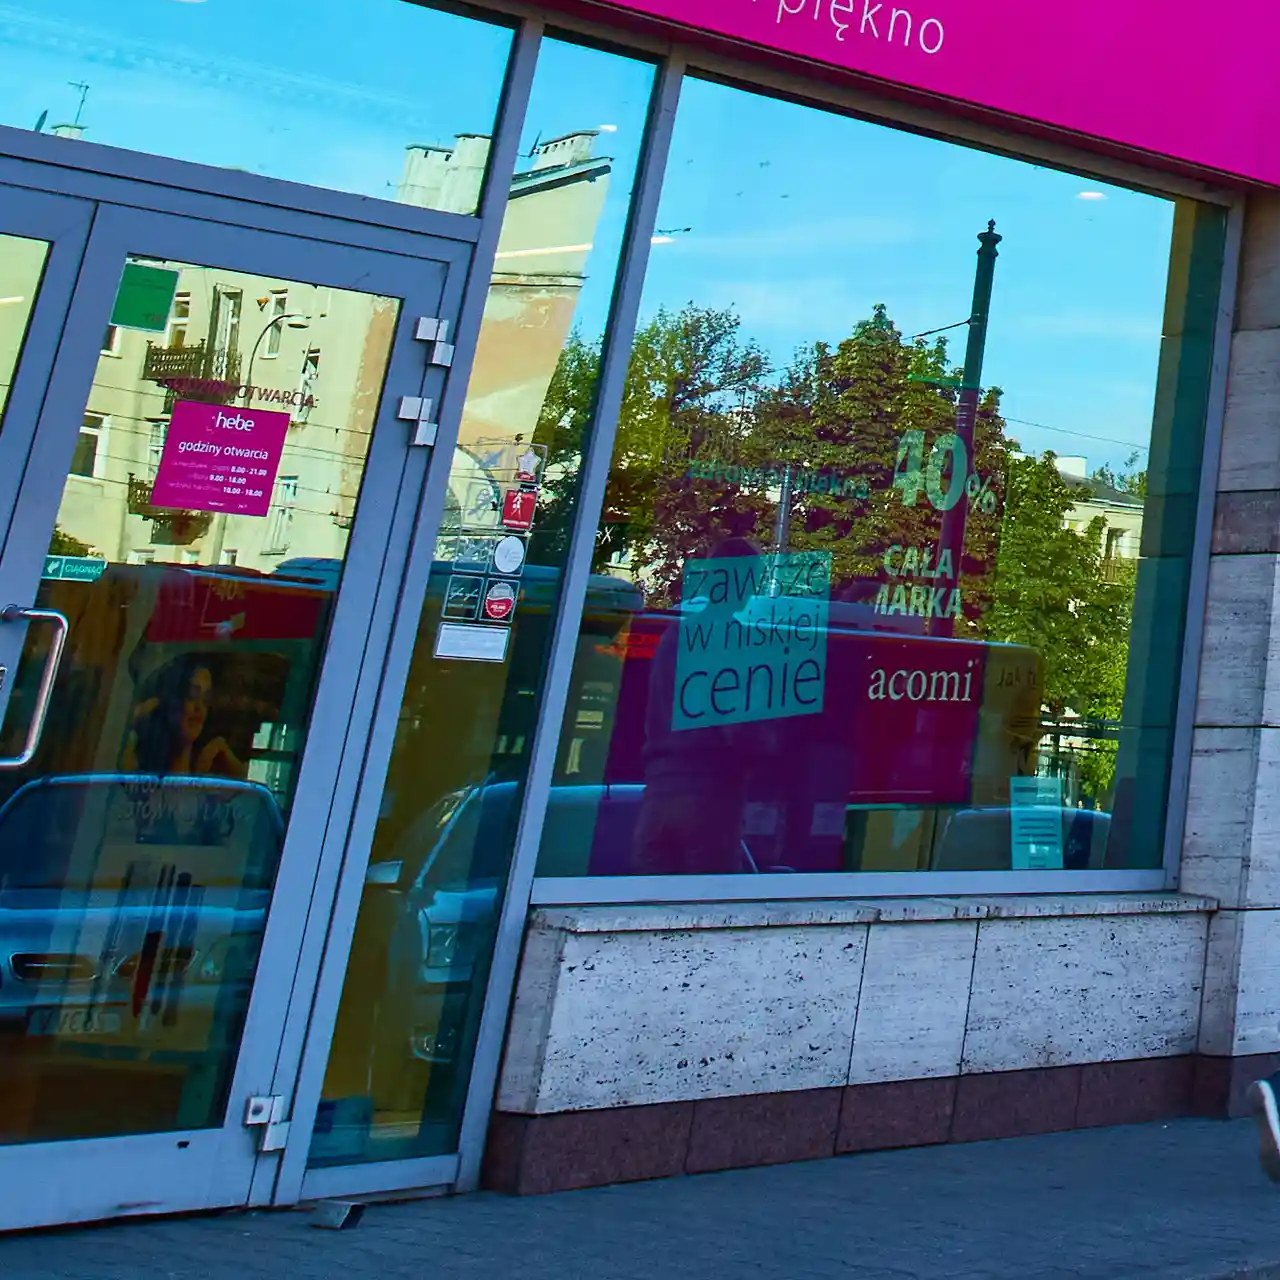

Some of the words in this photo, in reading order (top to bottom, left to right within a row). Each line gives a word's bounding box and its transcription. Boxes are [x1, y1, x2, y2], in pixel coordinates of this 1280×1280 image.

[215, 411, 255, 432] hebe
[178, 440, 223, 456] godziny
[223, 446, 269, 460] otwarcia
[892, 428, 998, 514] 40%
[687, 559, 827, 606] zawsze
[883, 543, 954, 580] CAŁA
[685, 620, 714, 653] w
[724, 604, 821, 652] niskiej
[679, 646, 821, 719] cenie
[867, 659, 974, 702] acomi
